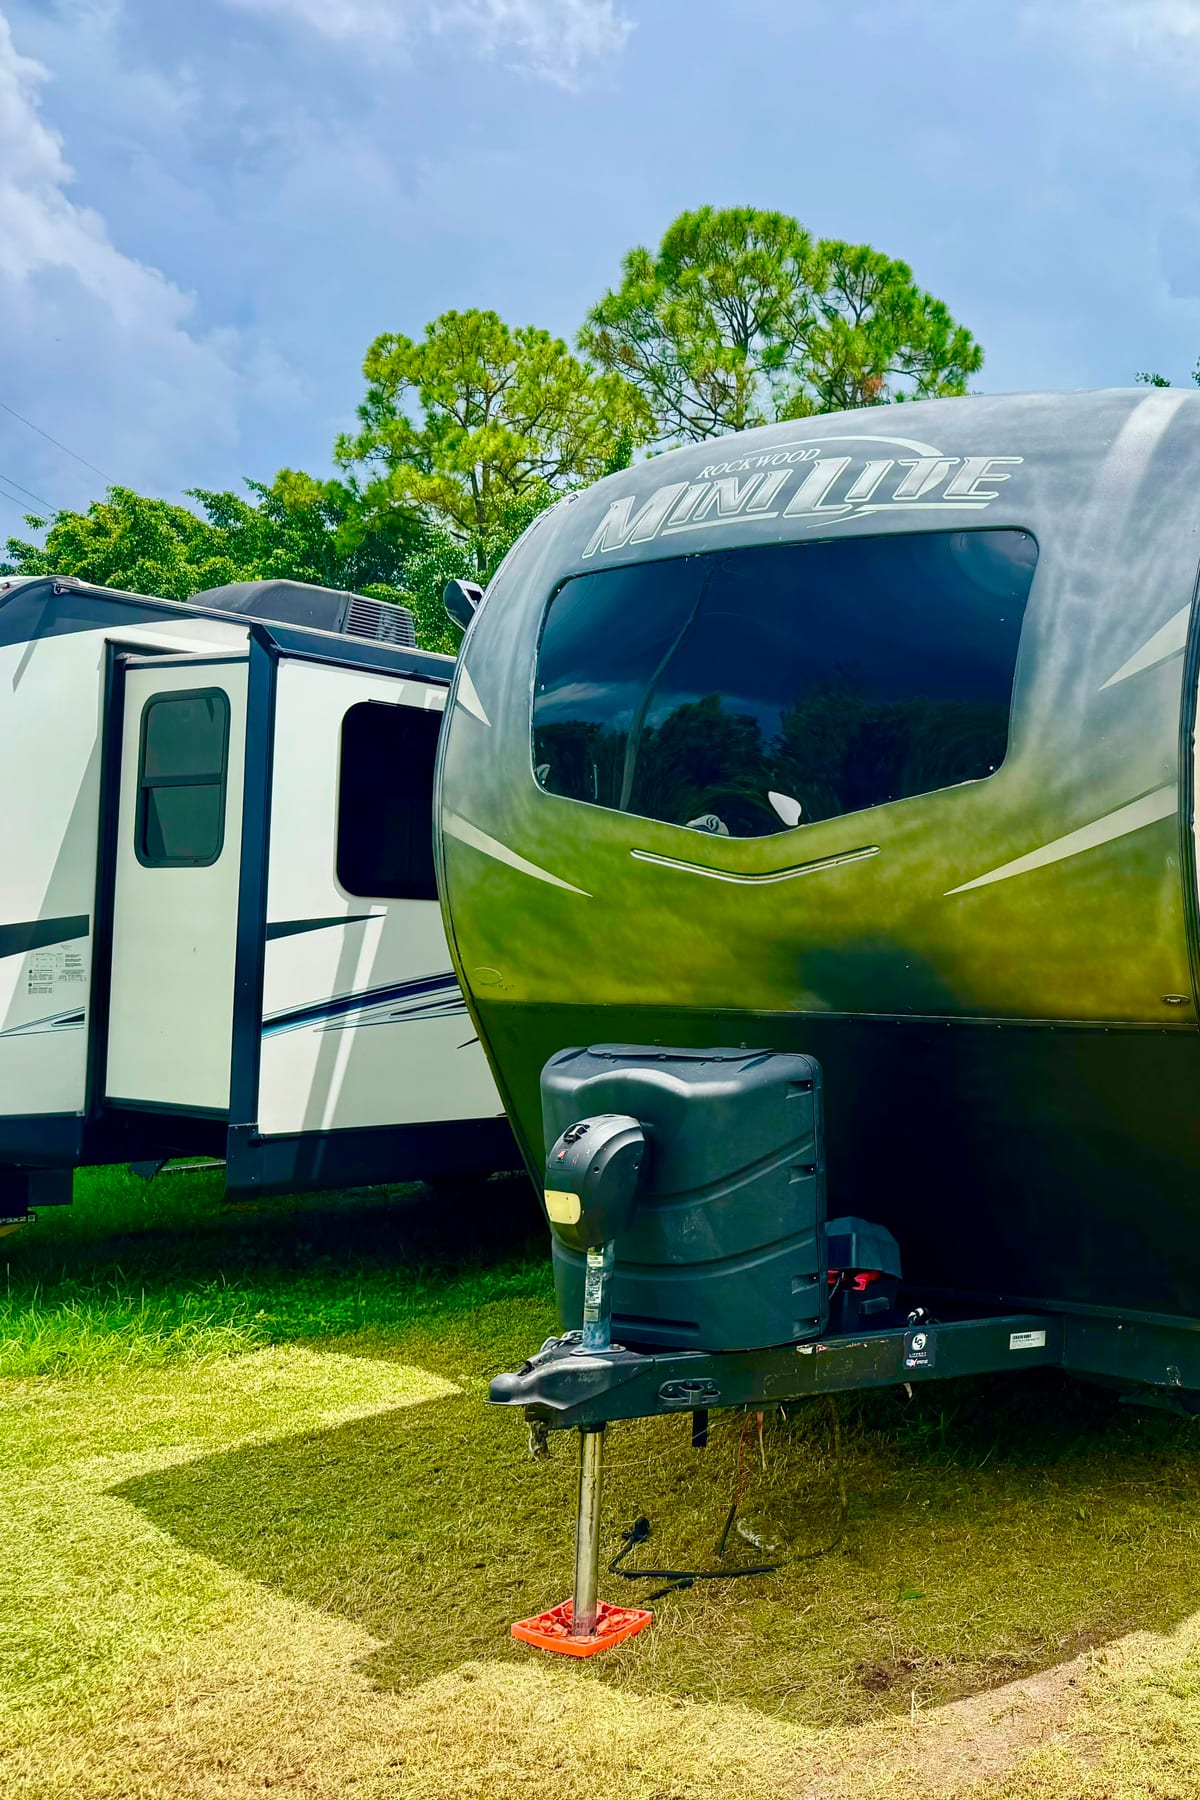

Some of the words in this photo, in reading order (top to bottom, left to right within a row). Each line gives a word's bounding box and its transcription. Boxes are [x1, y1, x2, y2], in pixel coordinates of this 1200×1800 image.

[695, 448, 821, 480] ROCKWOOD
[582, 468, 794, 559] MINI
[782, 456, 1025, 519] LITE
